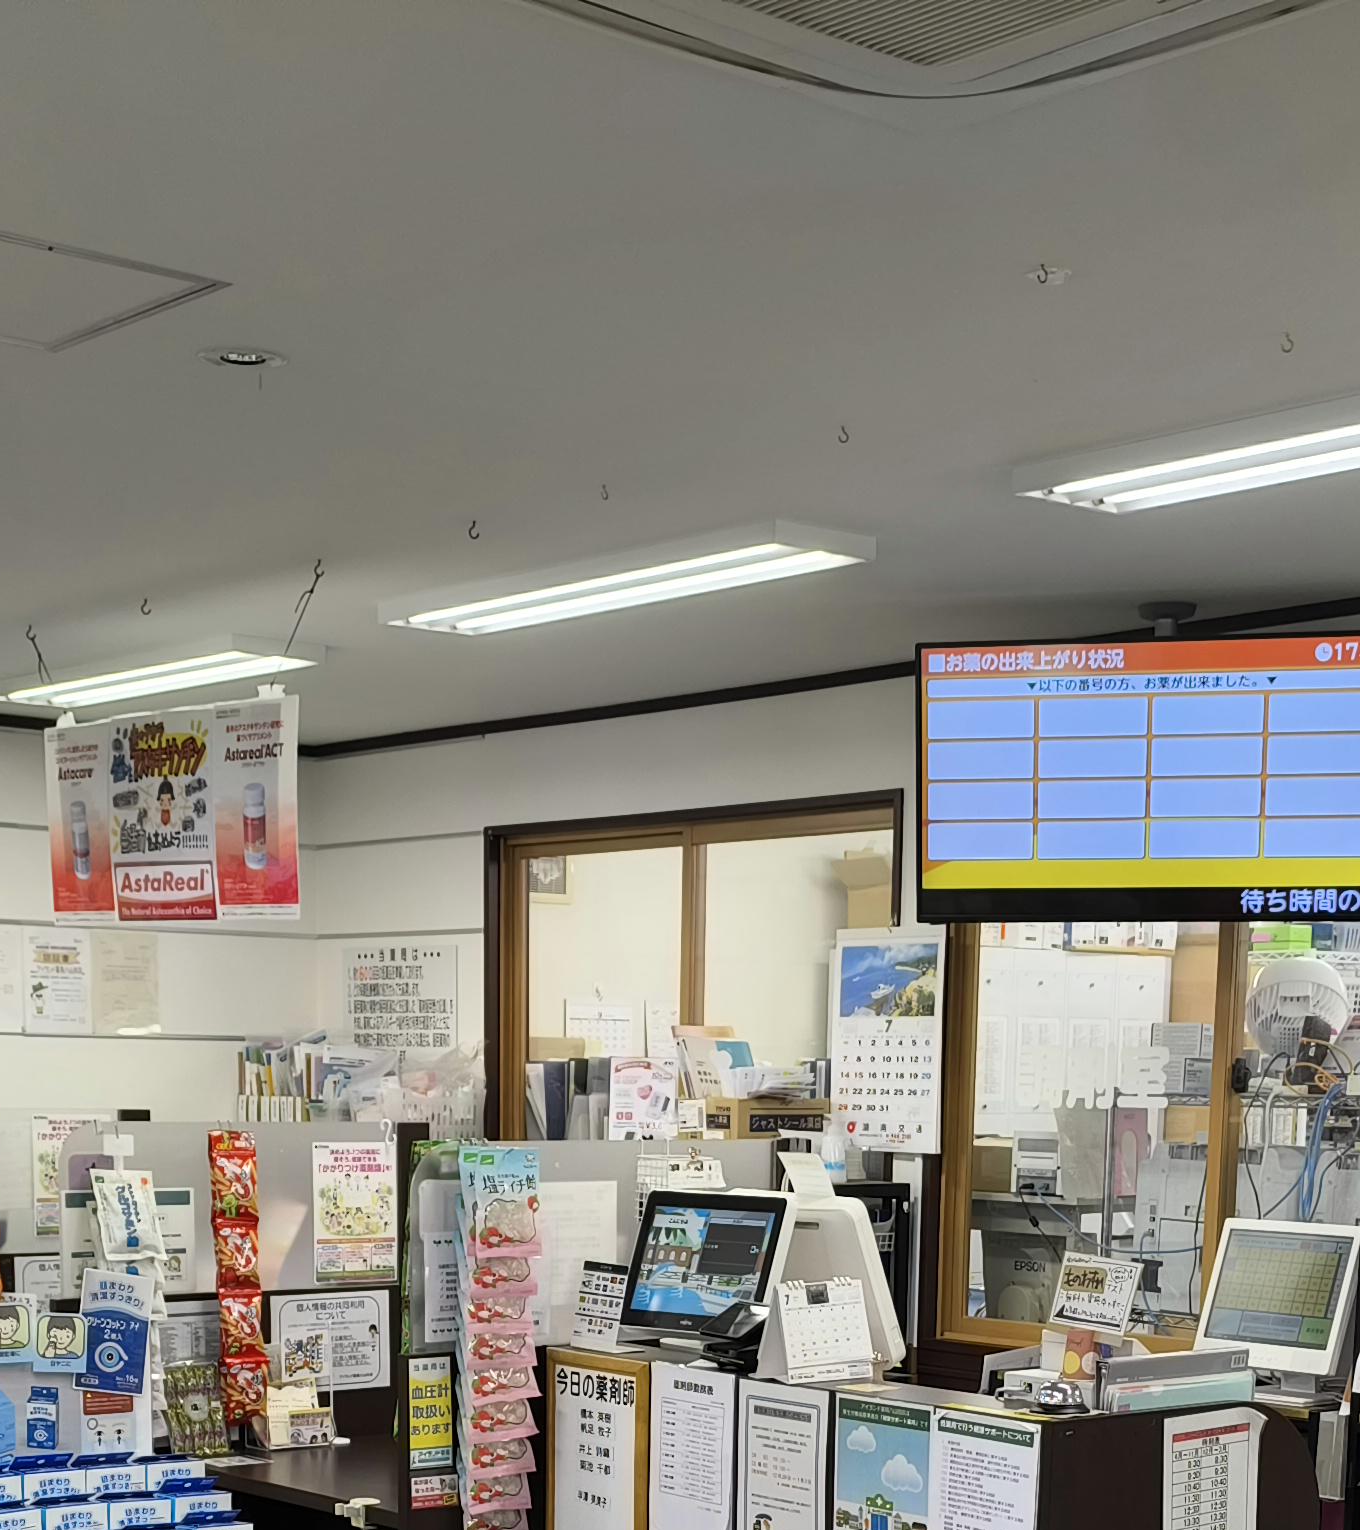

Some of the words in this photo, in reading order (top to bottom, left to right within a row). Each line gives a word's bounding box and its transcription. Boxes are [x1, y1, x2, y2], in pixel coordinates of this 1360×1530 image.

[944, 649, 1126, 672] お薬の出来上がり状況
[1037, 674, 1259, 694] 以下の番号の方、お薬が出来ました。
[120, 870, 206, 893] AstaReal
[885, 1019, 893, 1033] 7
[1013, 1259, 1046, 1273] EPSON
[99, 1280, 134, 1293] 目まわり
[295, 1300, 365, 1312] 個人情報の共同利用
[315, 1310, 347, 1321] について
[411, 1382, 449, 1400] 血圧計
[555, 1366, 636, 1408] 今日の薬剤師
[411, 1402, 451, 1419] 取扱い
[410, 1421, 452, 1436] あります
